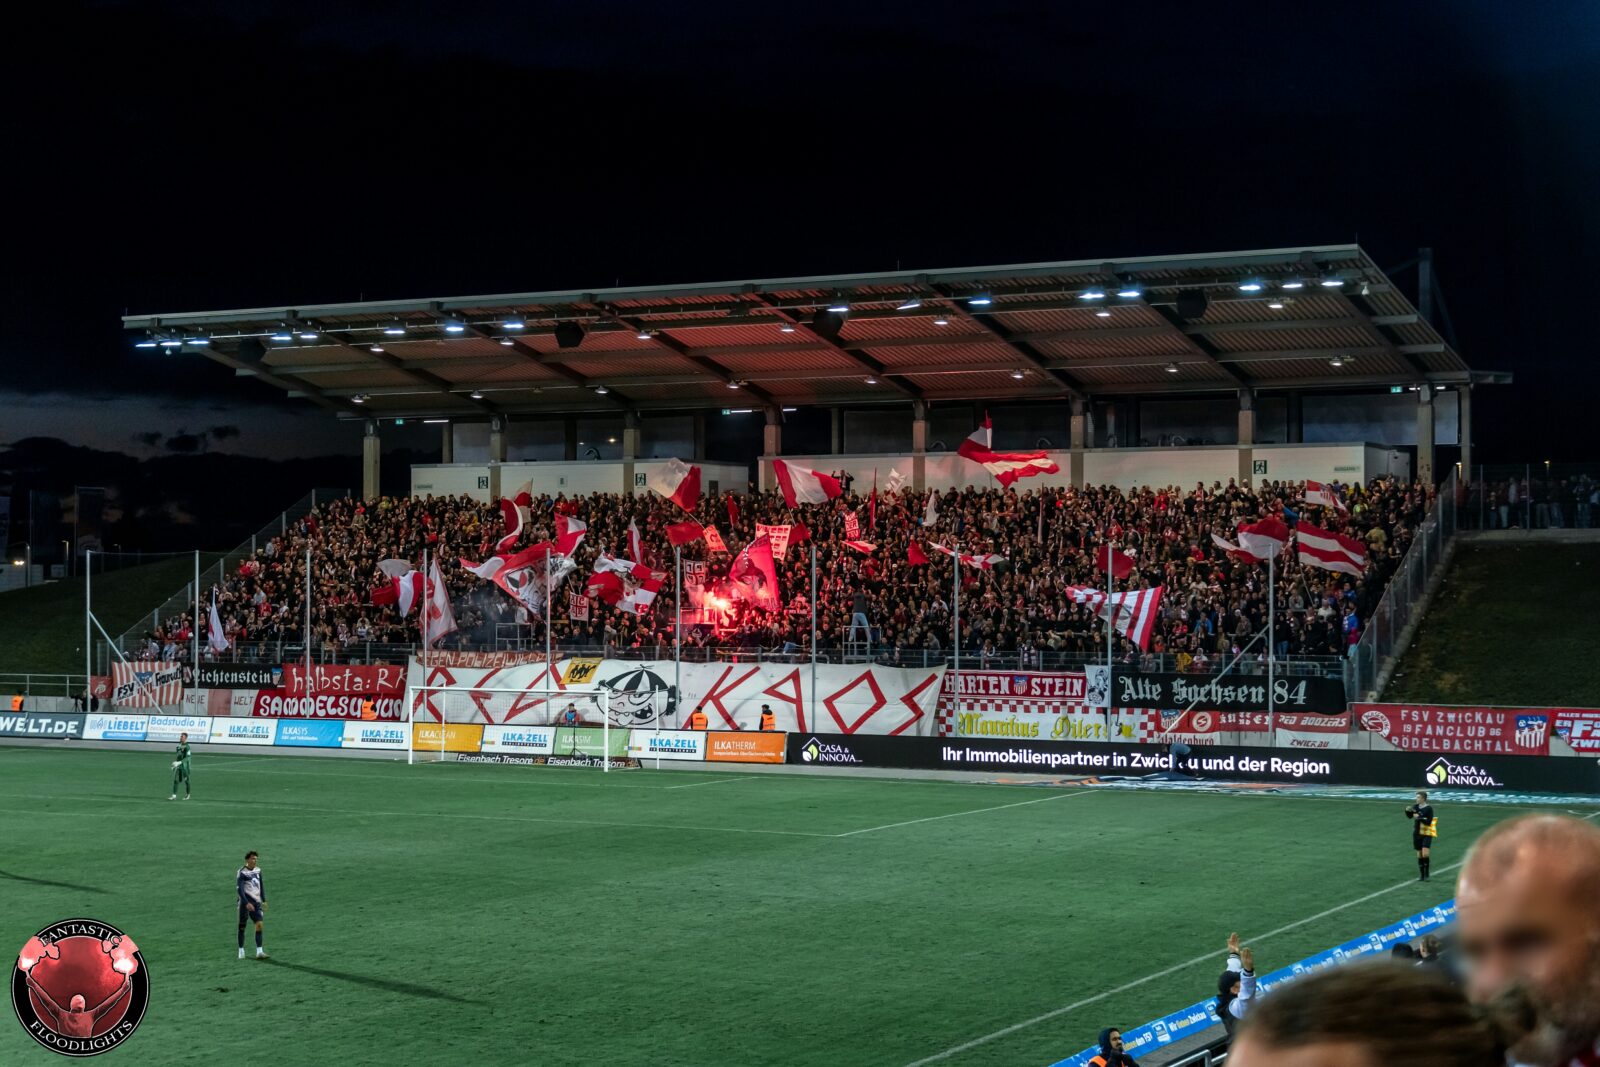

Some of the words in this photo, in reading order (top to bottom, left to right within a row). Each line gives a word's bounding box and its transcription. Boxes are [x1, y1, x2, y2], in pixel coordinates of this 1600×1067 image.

[945, 675, 1010, 695] HARTEN
[1031, 677, 1083, 696] STEIN
[1119, 676, 1162, 703] Alte
[1273, 679, 1307, 705] 84
[234, 696, 254, 706] WELT
[681, 665, 940, 736] KAOS
[151, 716, 195, 727] Badstudio
[198, 718, 206, 727] in
[1401, 710, 1430, 722] FSV
[1436, 711, 1505, 725] ZWICKAU
[1415, 724, 1485, 737] FANCLUB
[714, 740, 756, 750] ILKATHERM
[819, 744, 841, 753] CASA
[1391, 734, 1513, 752] RÖDELBACHTAL
[457, 754, 501, 764] Eisenbach
[547, 757, 591, 767] Eisenbach
[819, 753, 856, 762] INNOVA
[942, 747, 963, 761] Ihr
[966, 747, 1109, 767] Immobilienpartner
[1113, 752, 1127, 766] in
[1202, 755, 1235, 771] und
[1238, 757, 1267, 772] der
[1271, 758, 1330, 777] Region
[1447, 764, 1476, 775] CASA
[1447, 775, 1495, 786] INNOVA
